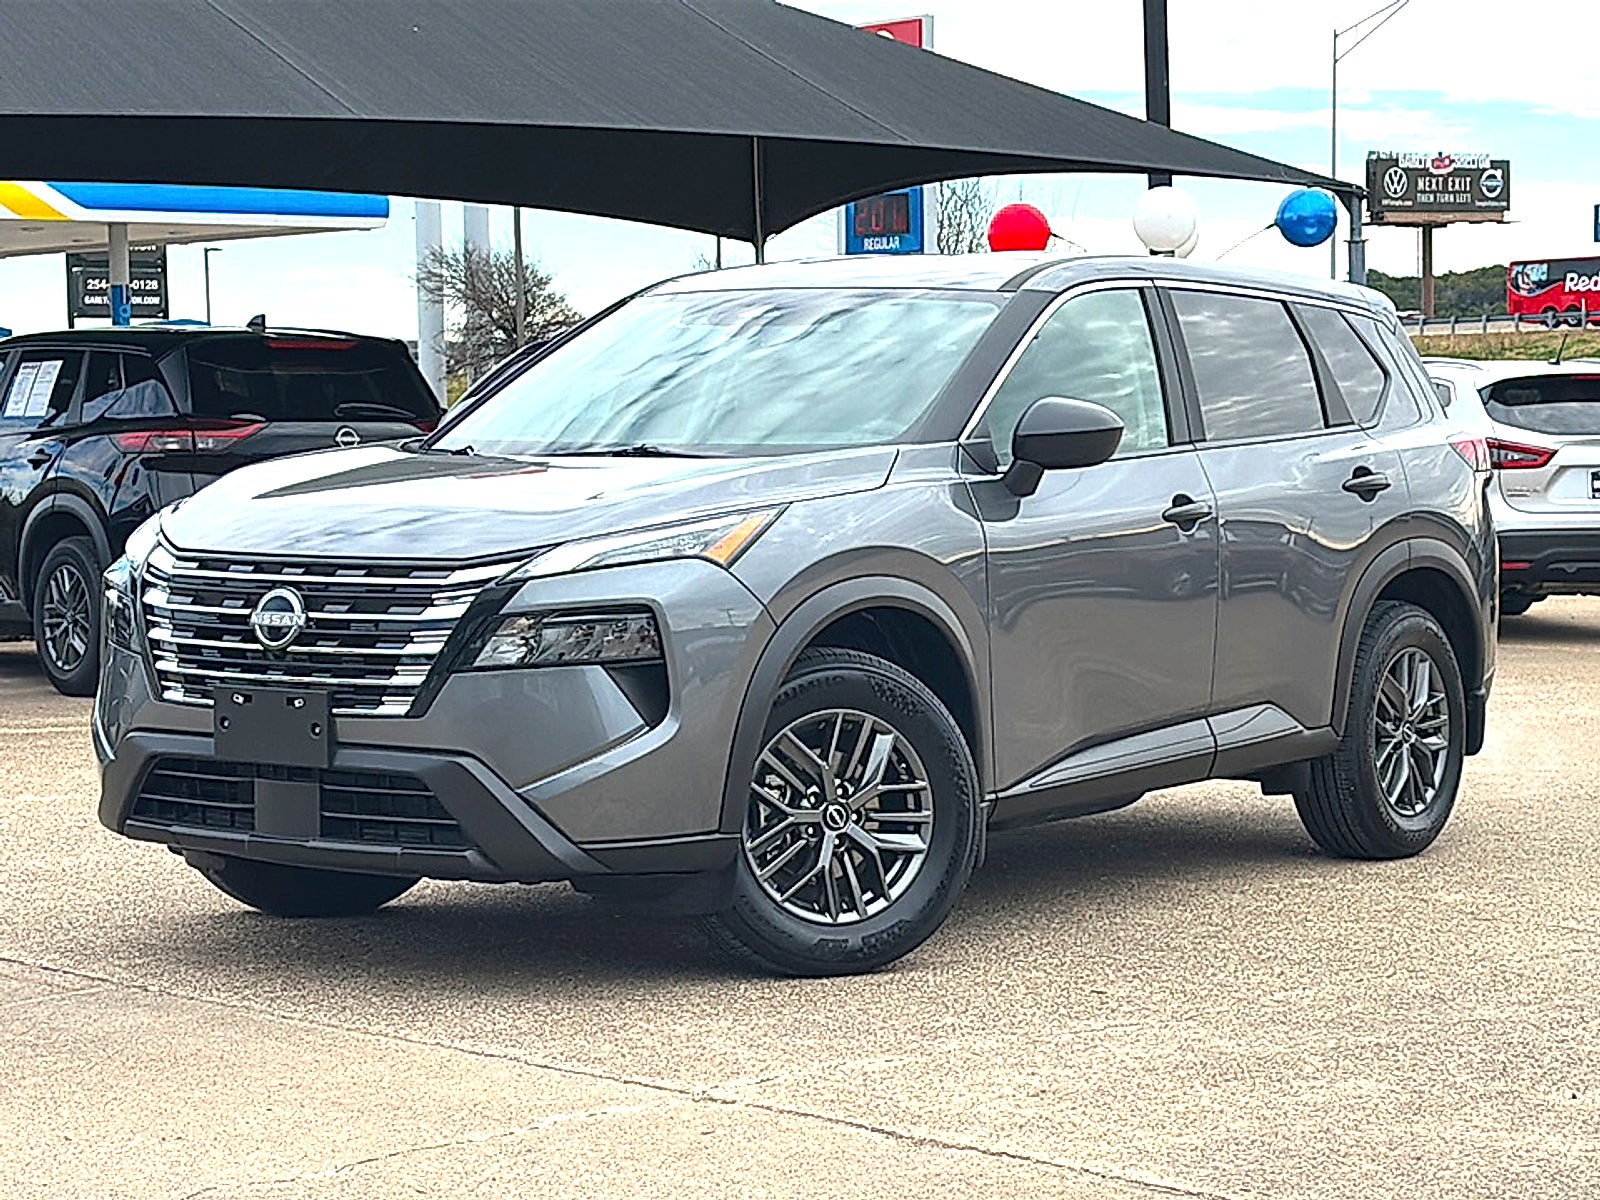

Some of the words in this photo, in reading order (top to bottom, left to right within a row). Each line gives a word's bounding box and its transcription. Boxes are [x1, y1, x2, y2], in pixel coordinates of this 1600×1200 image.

[1417, 176, 1443, 191] NEXT
[1448, 176, 1472, 191] EXIT
[1436, 192, 1455, 204] TURN
[1455, 192, 1472, 204] LEFT
[863, 236, 901, 251] REGULAR
[1564, 270, 1600, 293] Red
[253, 613, 304, 626] NISSAN
